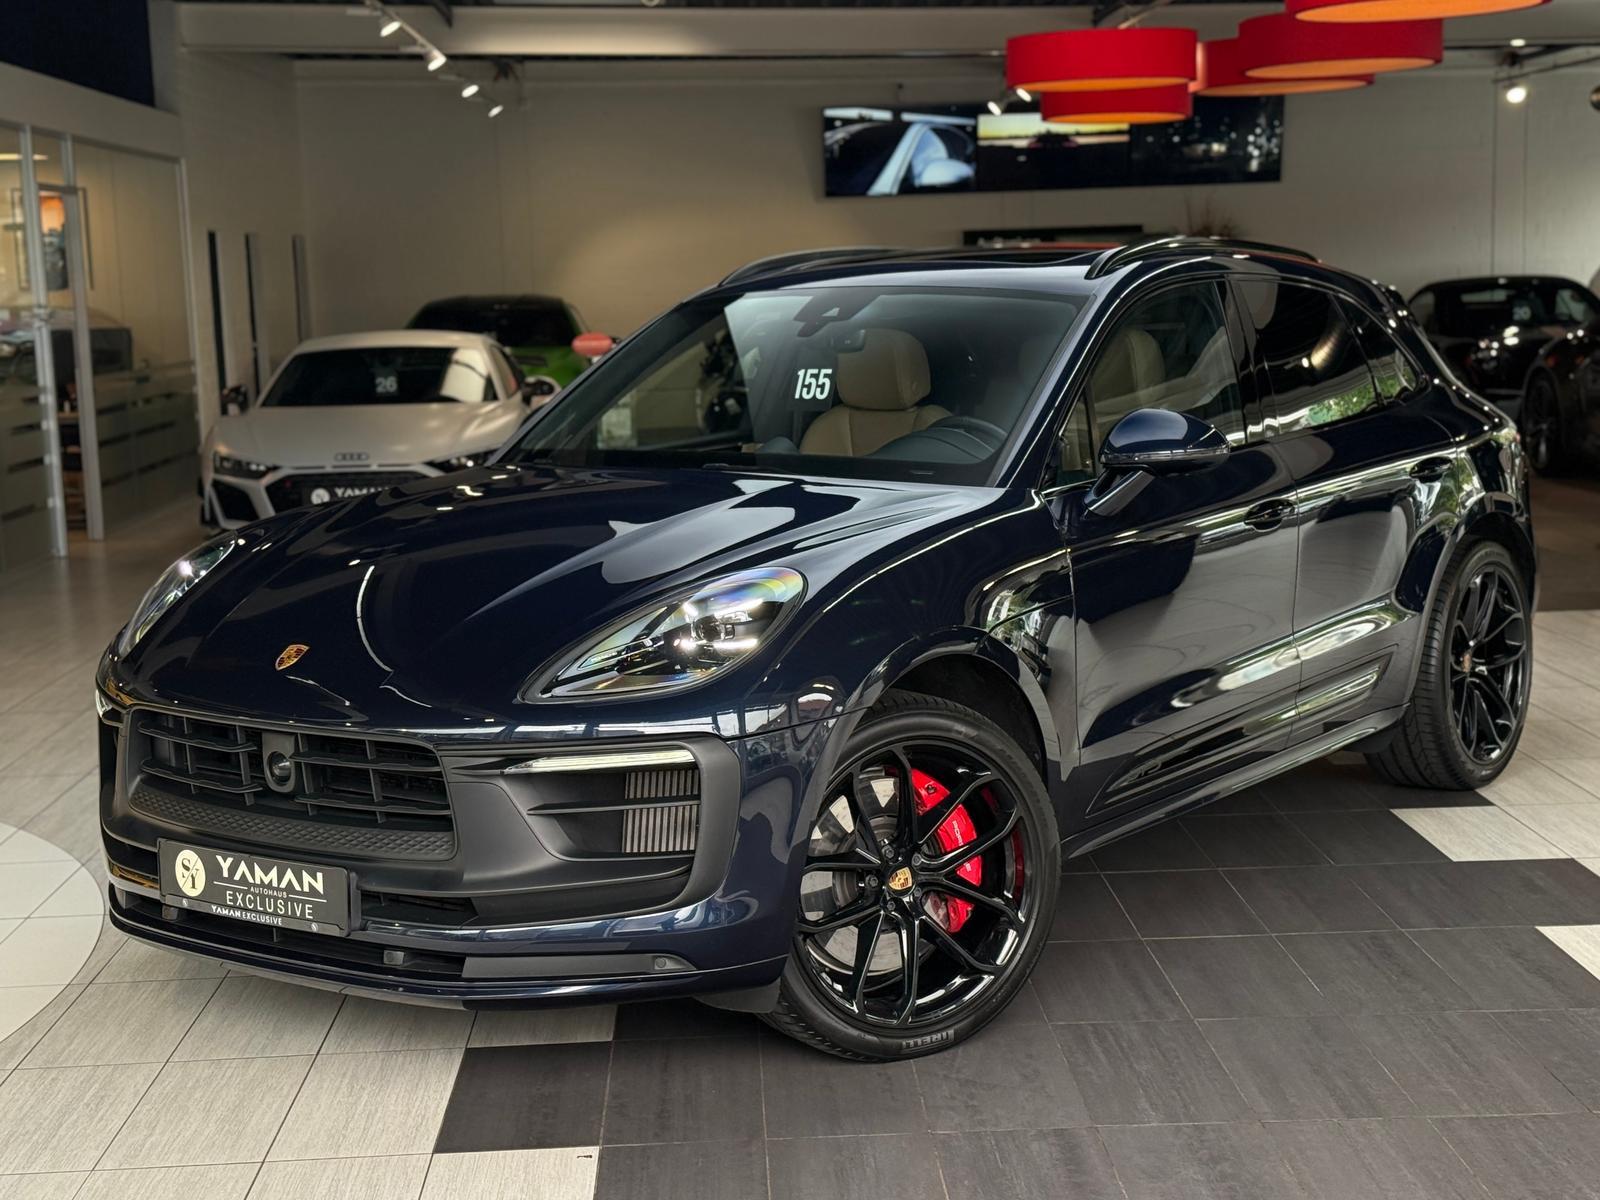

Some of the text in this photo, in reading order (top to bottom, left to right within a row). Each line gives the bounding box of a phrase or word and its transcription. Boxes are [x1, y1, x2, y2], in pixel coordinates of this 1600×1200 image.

[375, 376, 397, 393] 26
[795, 368, 833, 400] 155
[334, 486, 389, 498] YAM
[215, 854, 324, 895] YAMAN
[250, 886, 287, 898] AUTOHAUS
[211, 904, 282, 926] YAMAN EXCLUSIVE
[226, 890, 313, 919] EXCLUSIVE
